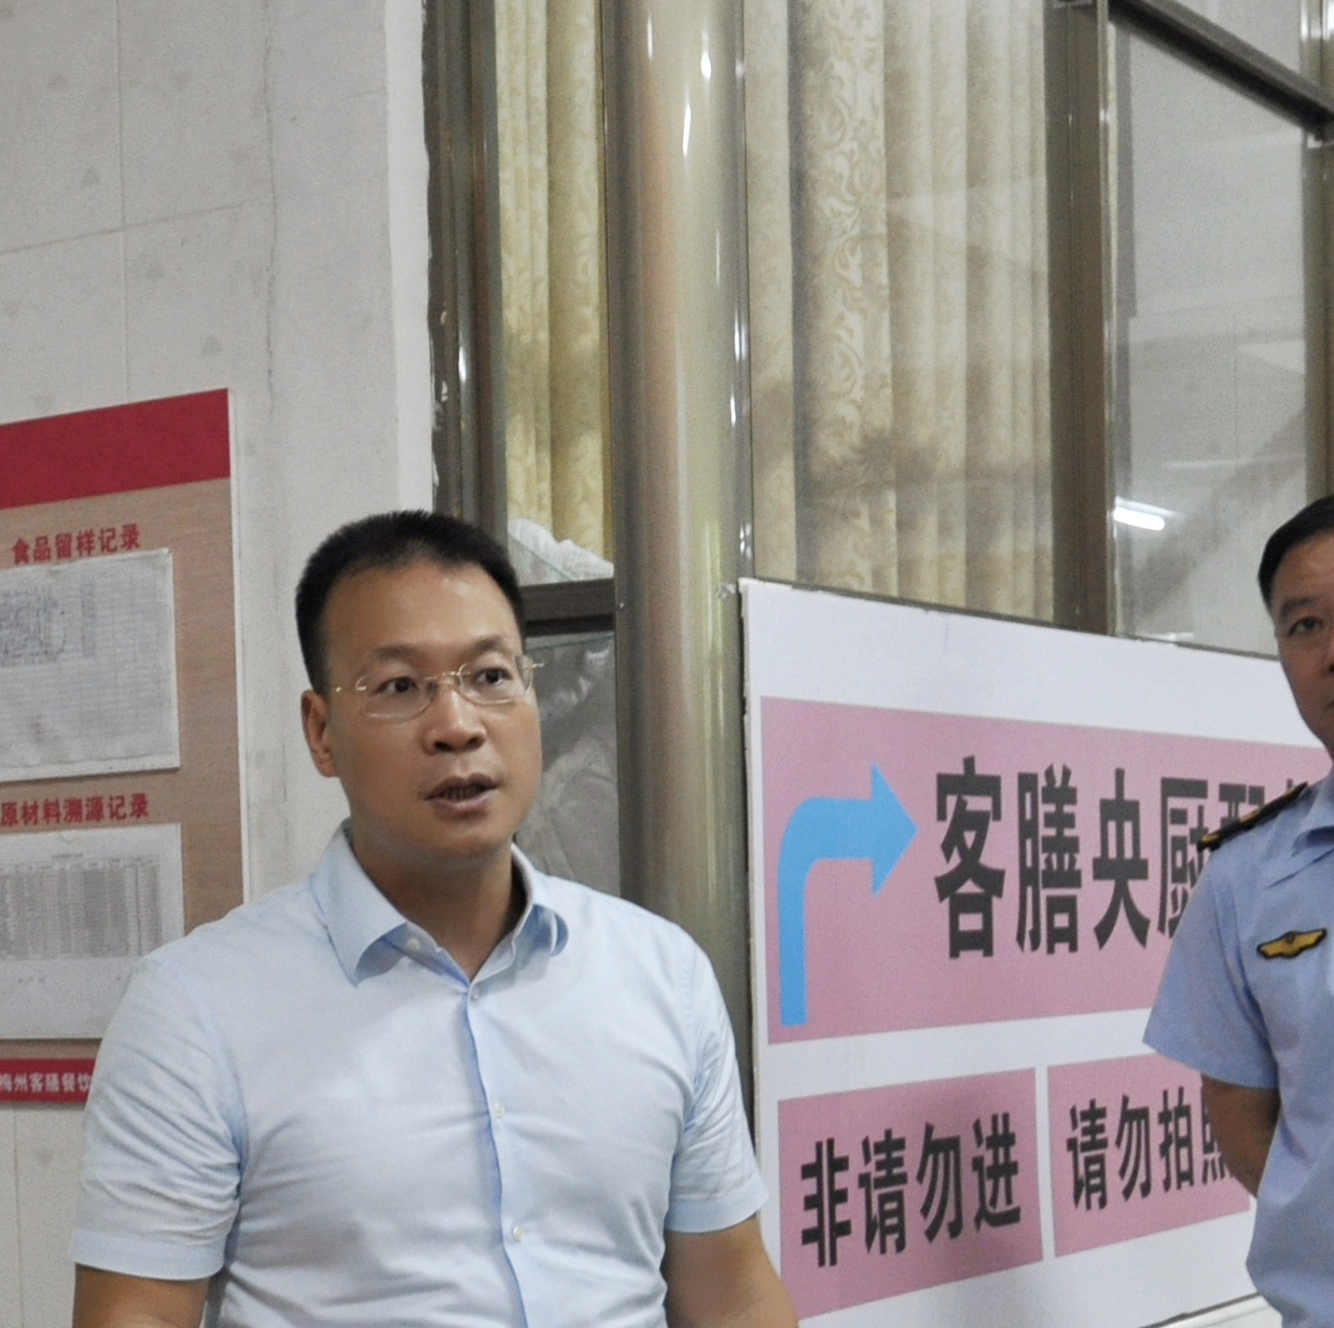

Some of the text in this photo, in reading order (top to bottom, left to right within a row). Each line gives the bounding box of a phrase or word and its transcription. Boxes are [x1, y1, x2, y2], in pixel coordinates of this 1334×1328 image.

[12, 523, 140, 565] 食品留样记录
[0, 793, 149, 827] 原材料溯源记录
[934, 755, 1293, 959] 客膳央厨
[801, 1112, 1021, 1268] 非请勿进
